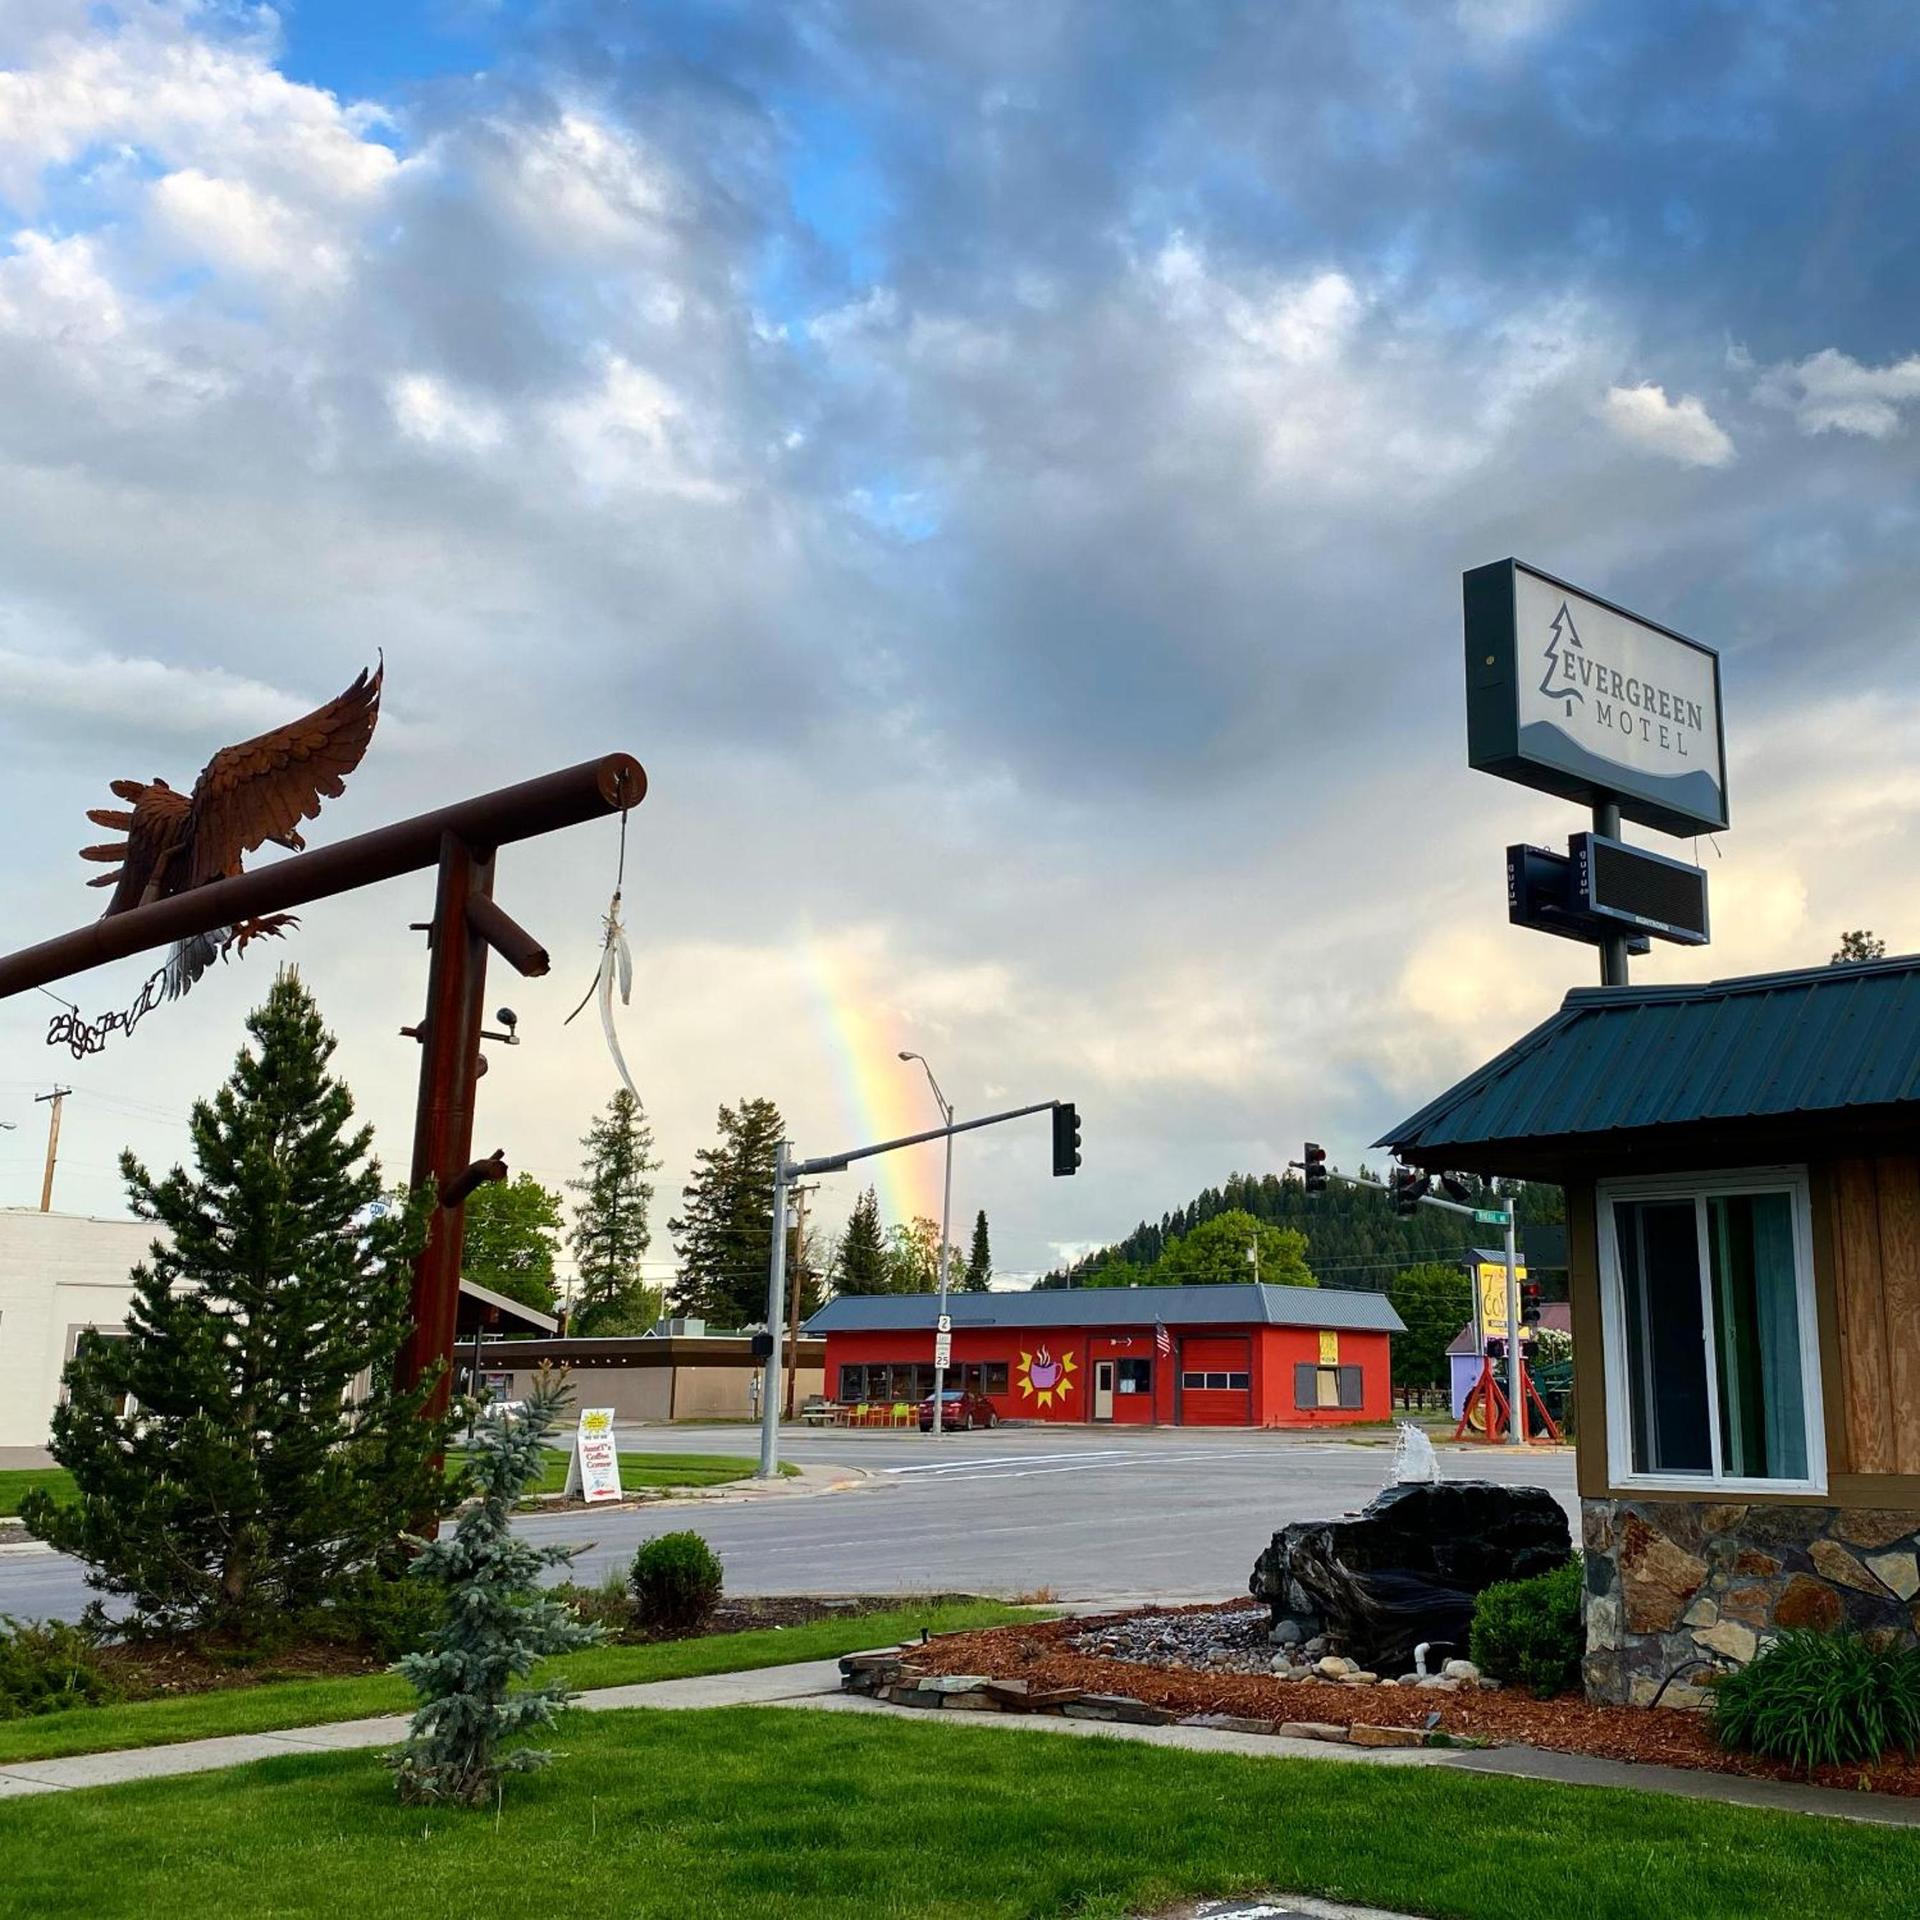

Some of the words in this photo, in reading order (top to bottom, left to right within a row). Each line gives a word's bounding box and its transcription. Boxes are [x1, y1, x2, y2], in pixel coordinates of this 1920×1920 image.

[1562, 651, 1703, 732] EVERGREEN
[1597, 700, 1688, 756] MOTEL
[942, 1318, 948, 1329] 2
[937, 1356, 948, 1366] 25
